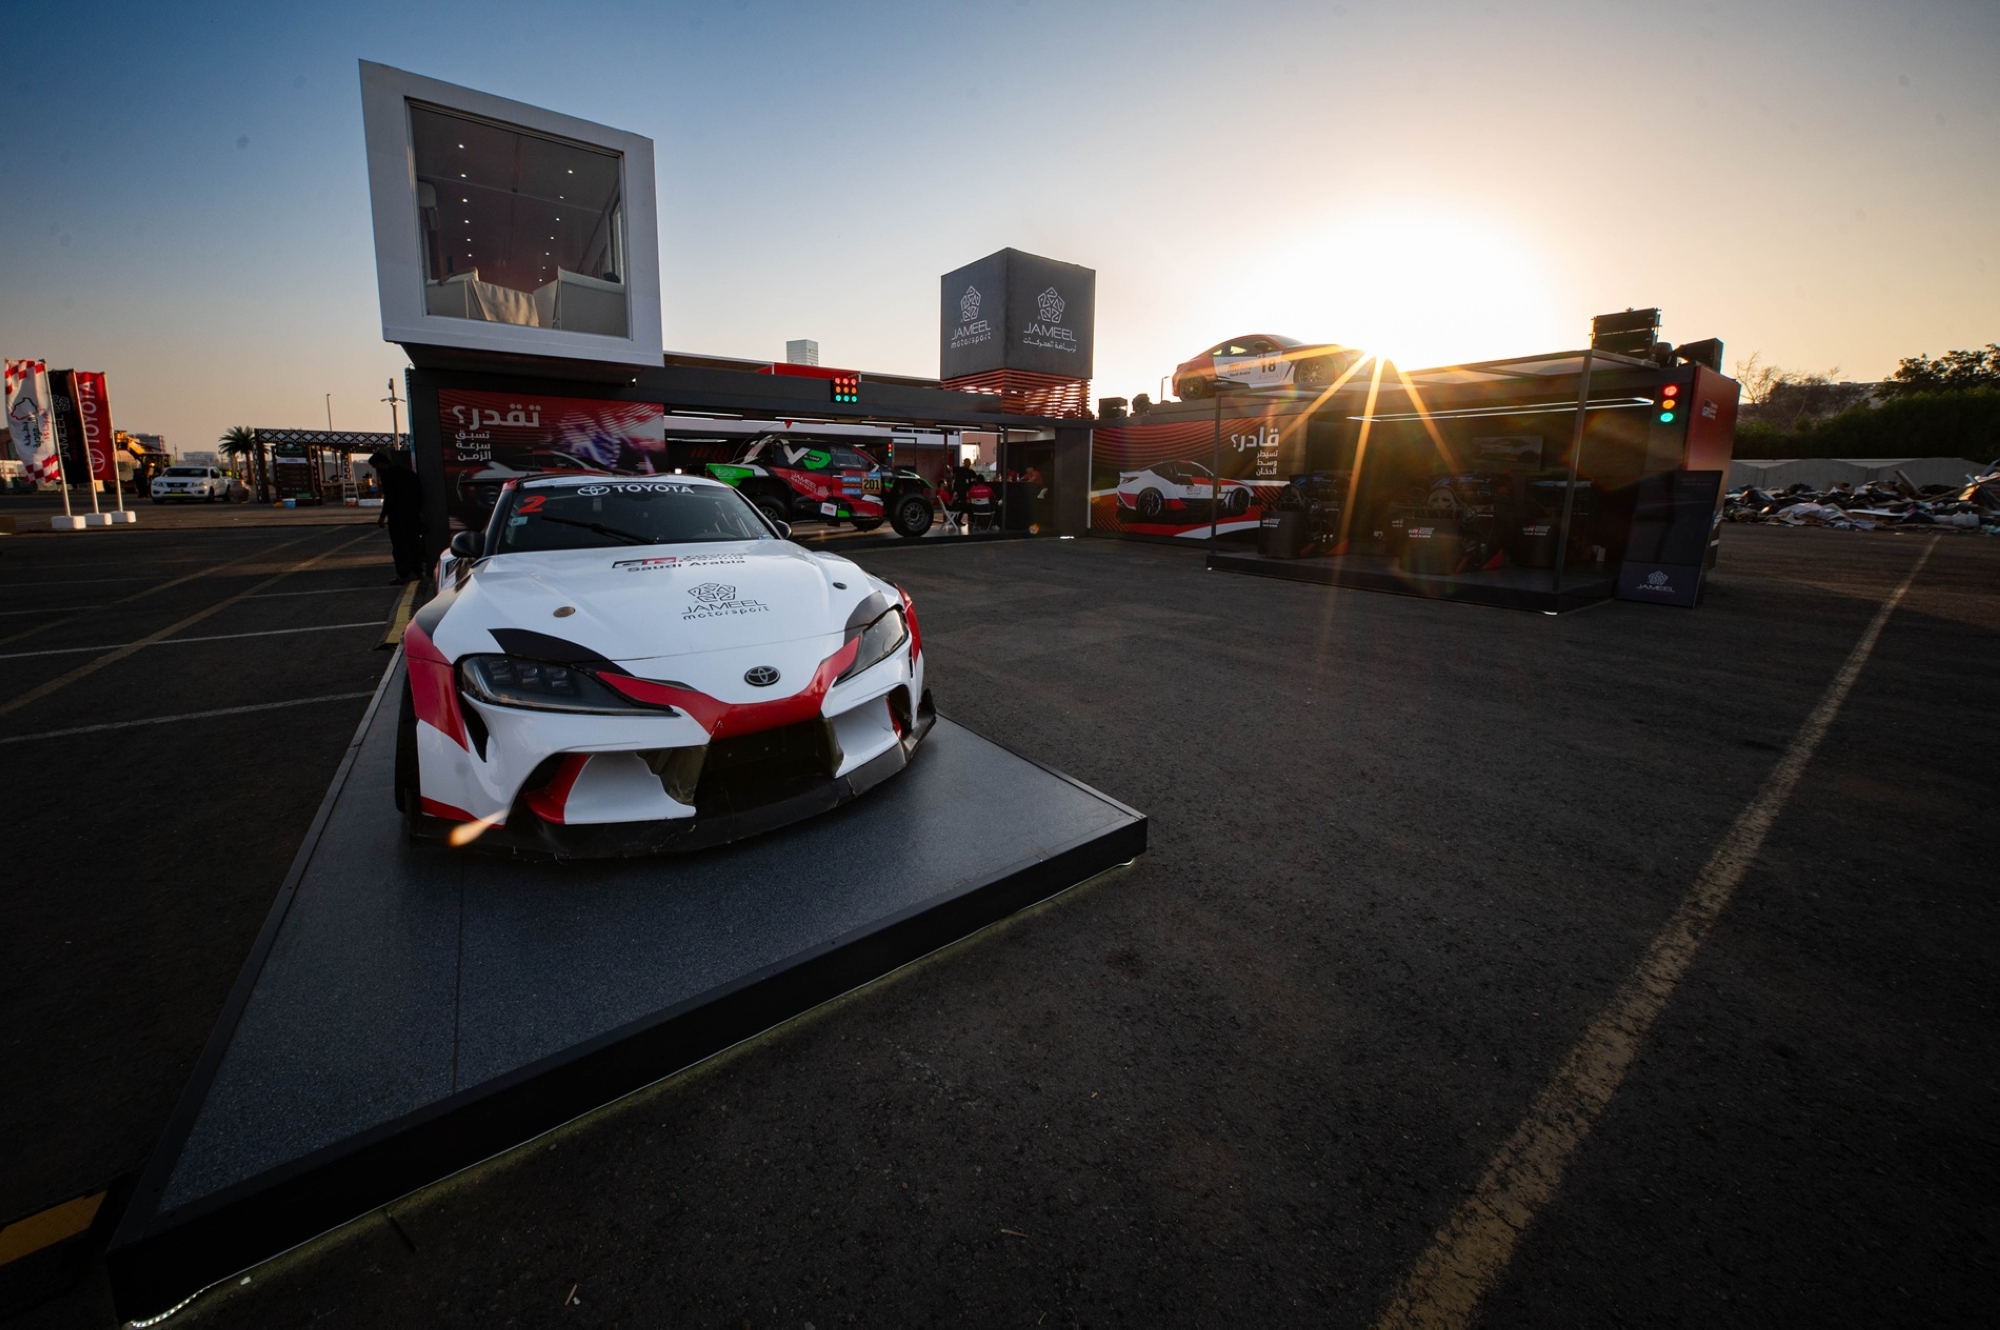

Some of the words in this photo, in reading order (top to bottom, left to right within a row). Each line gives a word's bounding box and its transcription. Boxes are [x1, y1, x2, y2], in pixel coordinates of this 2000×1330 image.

[950, 319, 992, 341] JAMEEL
[1023, 322, 1077, 342] JAMEEL
[950, 332, 992, 350] motorsport
[1260, 360, 1276, 373] 18
[79, 380, 101, 444] TOYOTA
[452, 403, 541, 431] تقدر؟
[455, 430, 491, 440] تسبق
[1230, 426, 1280, 453] قادر؟
[456, 440, 491, 451] سرعة
[457, 450, 492, 461] الزمن
[1256, 449, 1279, 459] تسيطر
[1256, 458, 1278, 467] وسط
[612, 484, 695, 494] TOYOTA
[863, 479, 880, 490] 201
[518, 495, 548, 515] 2
[627, 563, 682, 572] Saudi
[680, 599, 767, 616] JAMEEL
[682, 606, 771, 621] motorsport
